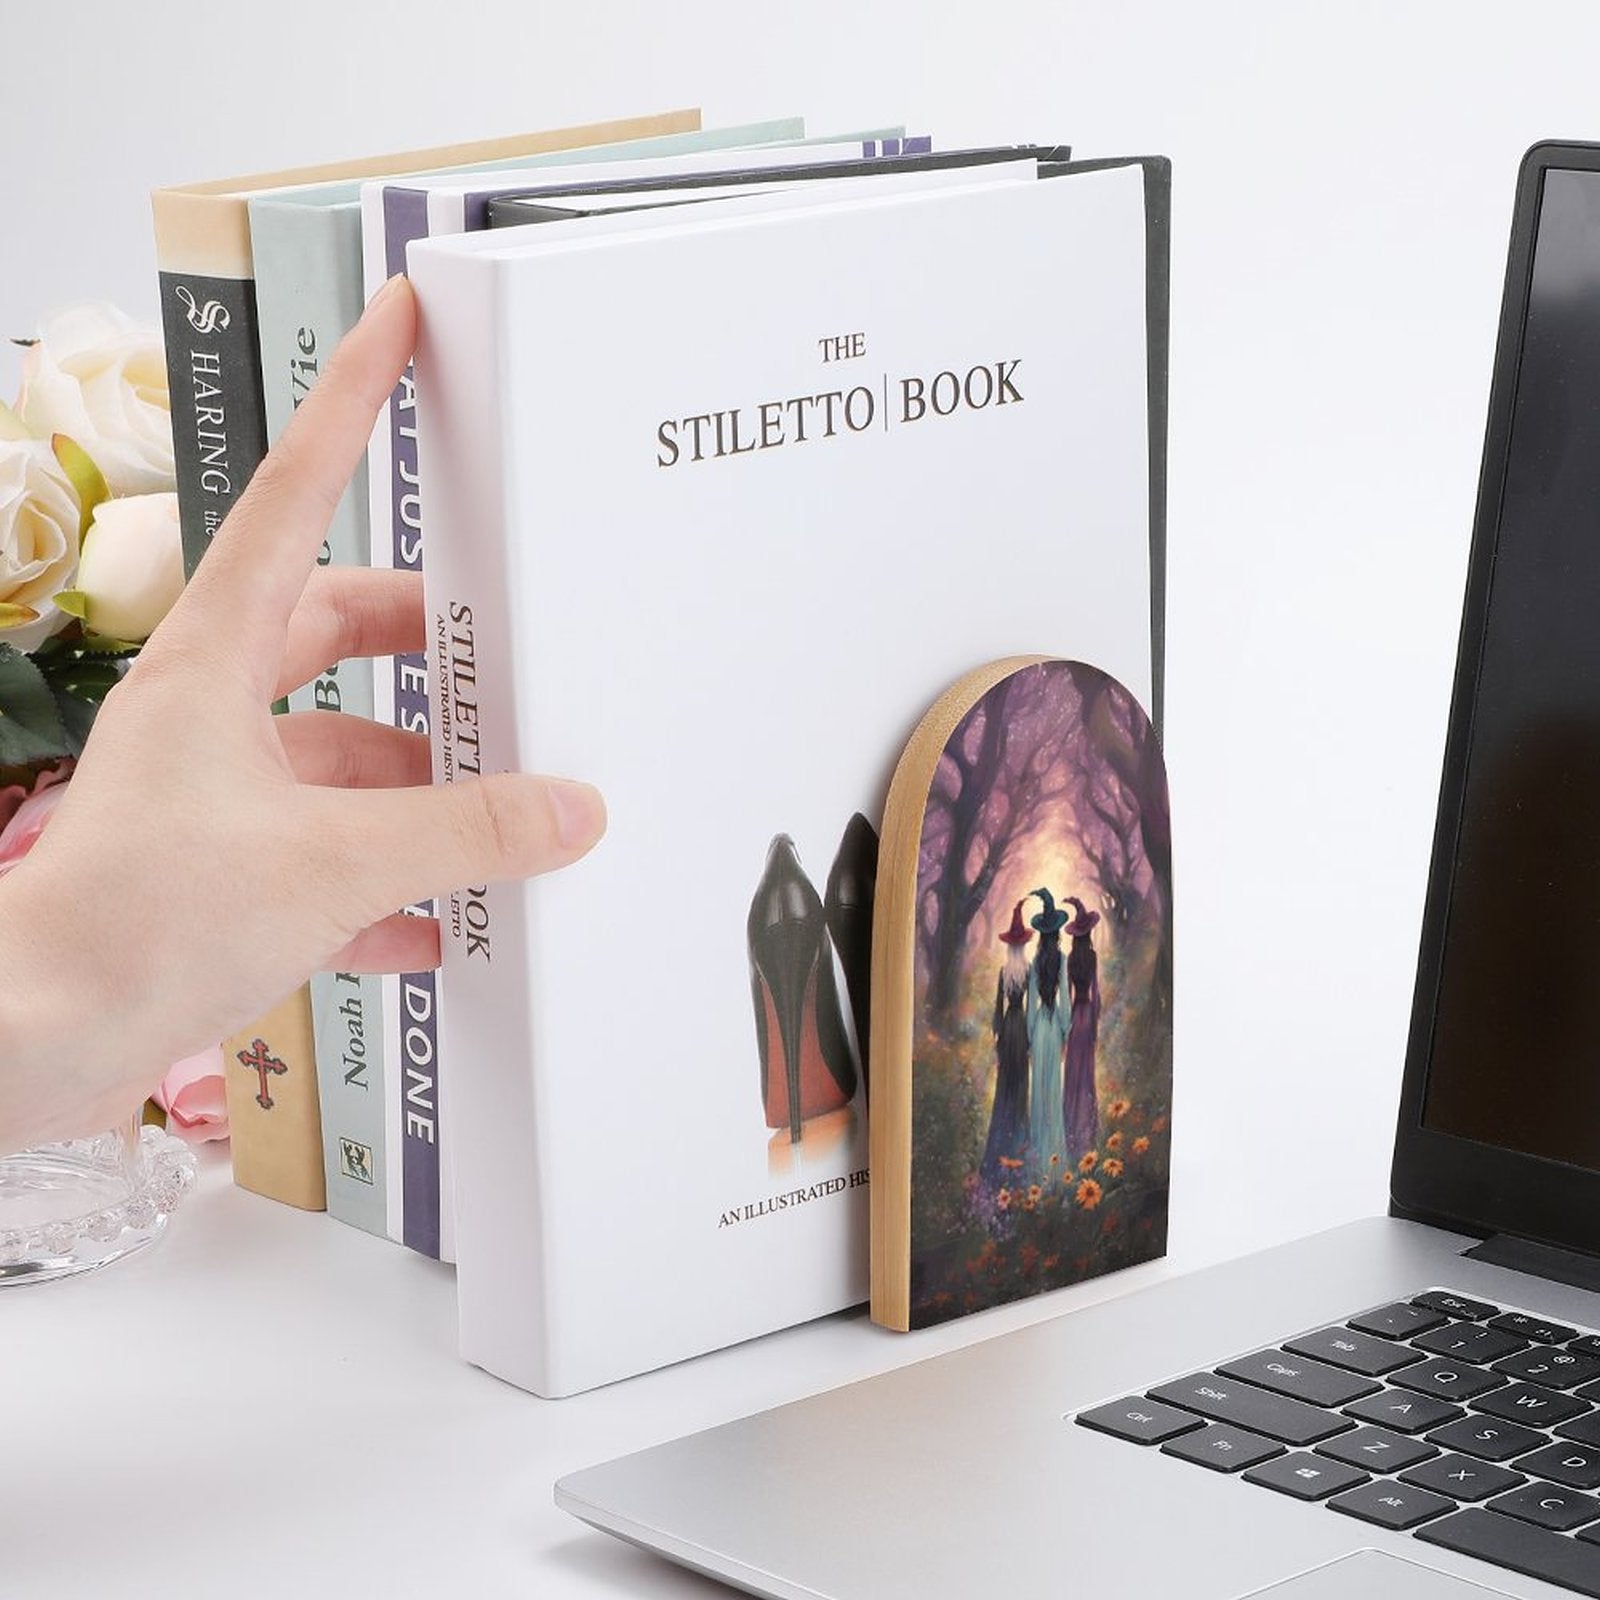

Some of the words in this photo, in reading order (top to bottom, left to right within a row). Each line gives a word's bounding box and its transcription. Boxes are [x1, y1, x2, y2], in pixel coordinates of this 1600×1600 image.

[818, 332, 867, 363] THE
[657, 386, 875, 468] STILETTO
[899, 359, 1025, 423] BOOK
[437, 613, 447, 638] AN
[438, 640, 453, 742] ILLUSTRATED
[449, 601, 481, 777] STILETT
[339, 998, 368, 1091] Noah
[404, 983, 434, 1146] DONE
[718, 1207, 741, 1229] AN
[744, 1176, 847, 1221] ILLUSTRATED
[849, 1167, 870, 1189] HIS
[1433, 1371, 1459, 1384] Q
[1390, 1404, 1412, 1414] A
[1516, 1395, 1548, 1409] W
[1475, 1429, 1499, 1440] S
[1362, 1441, 1390, 1454] Z
[1561, 1456, 1587, 1468] D
[1448, 1469, 1476, 1481] X
[1539, 1498, 1565, 1511] C
